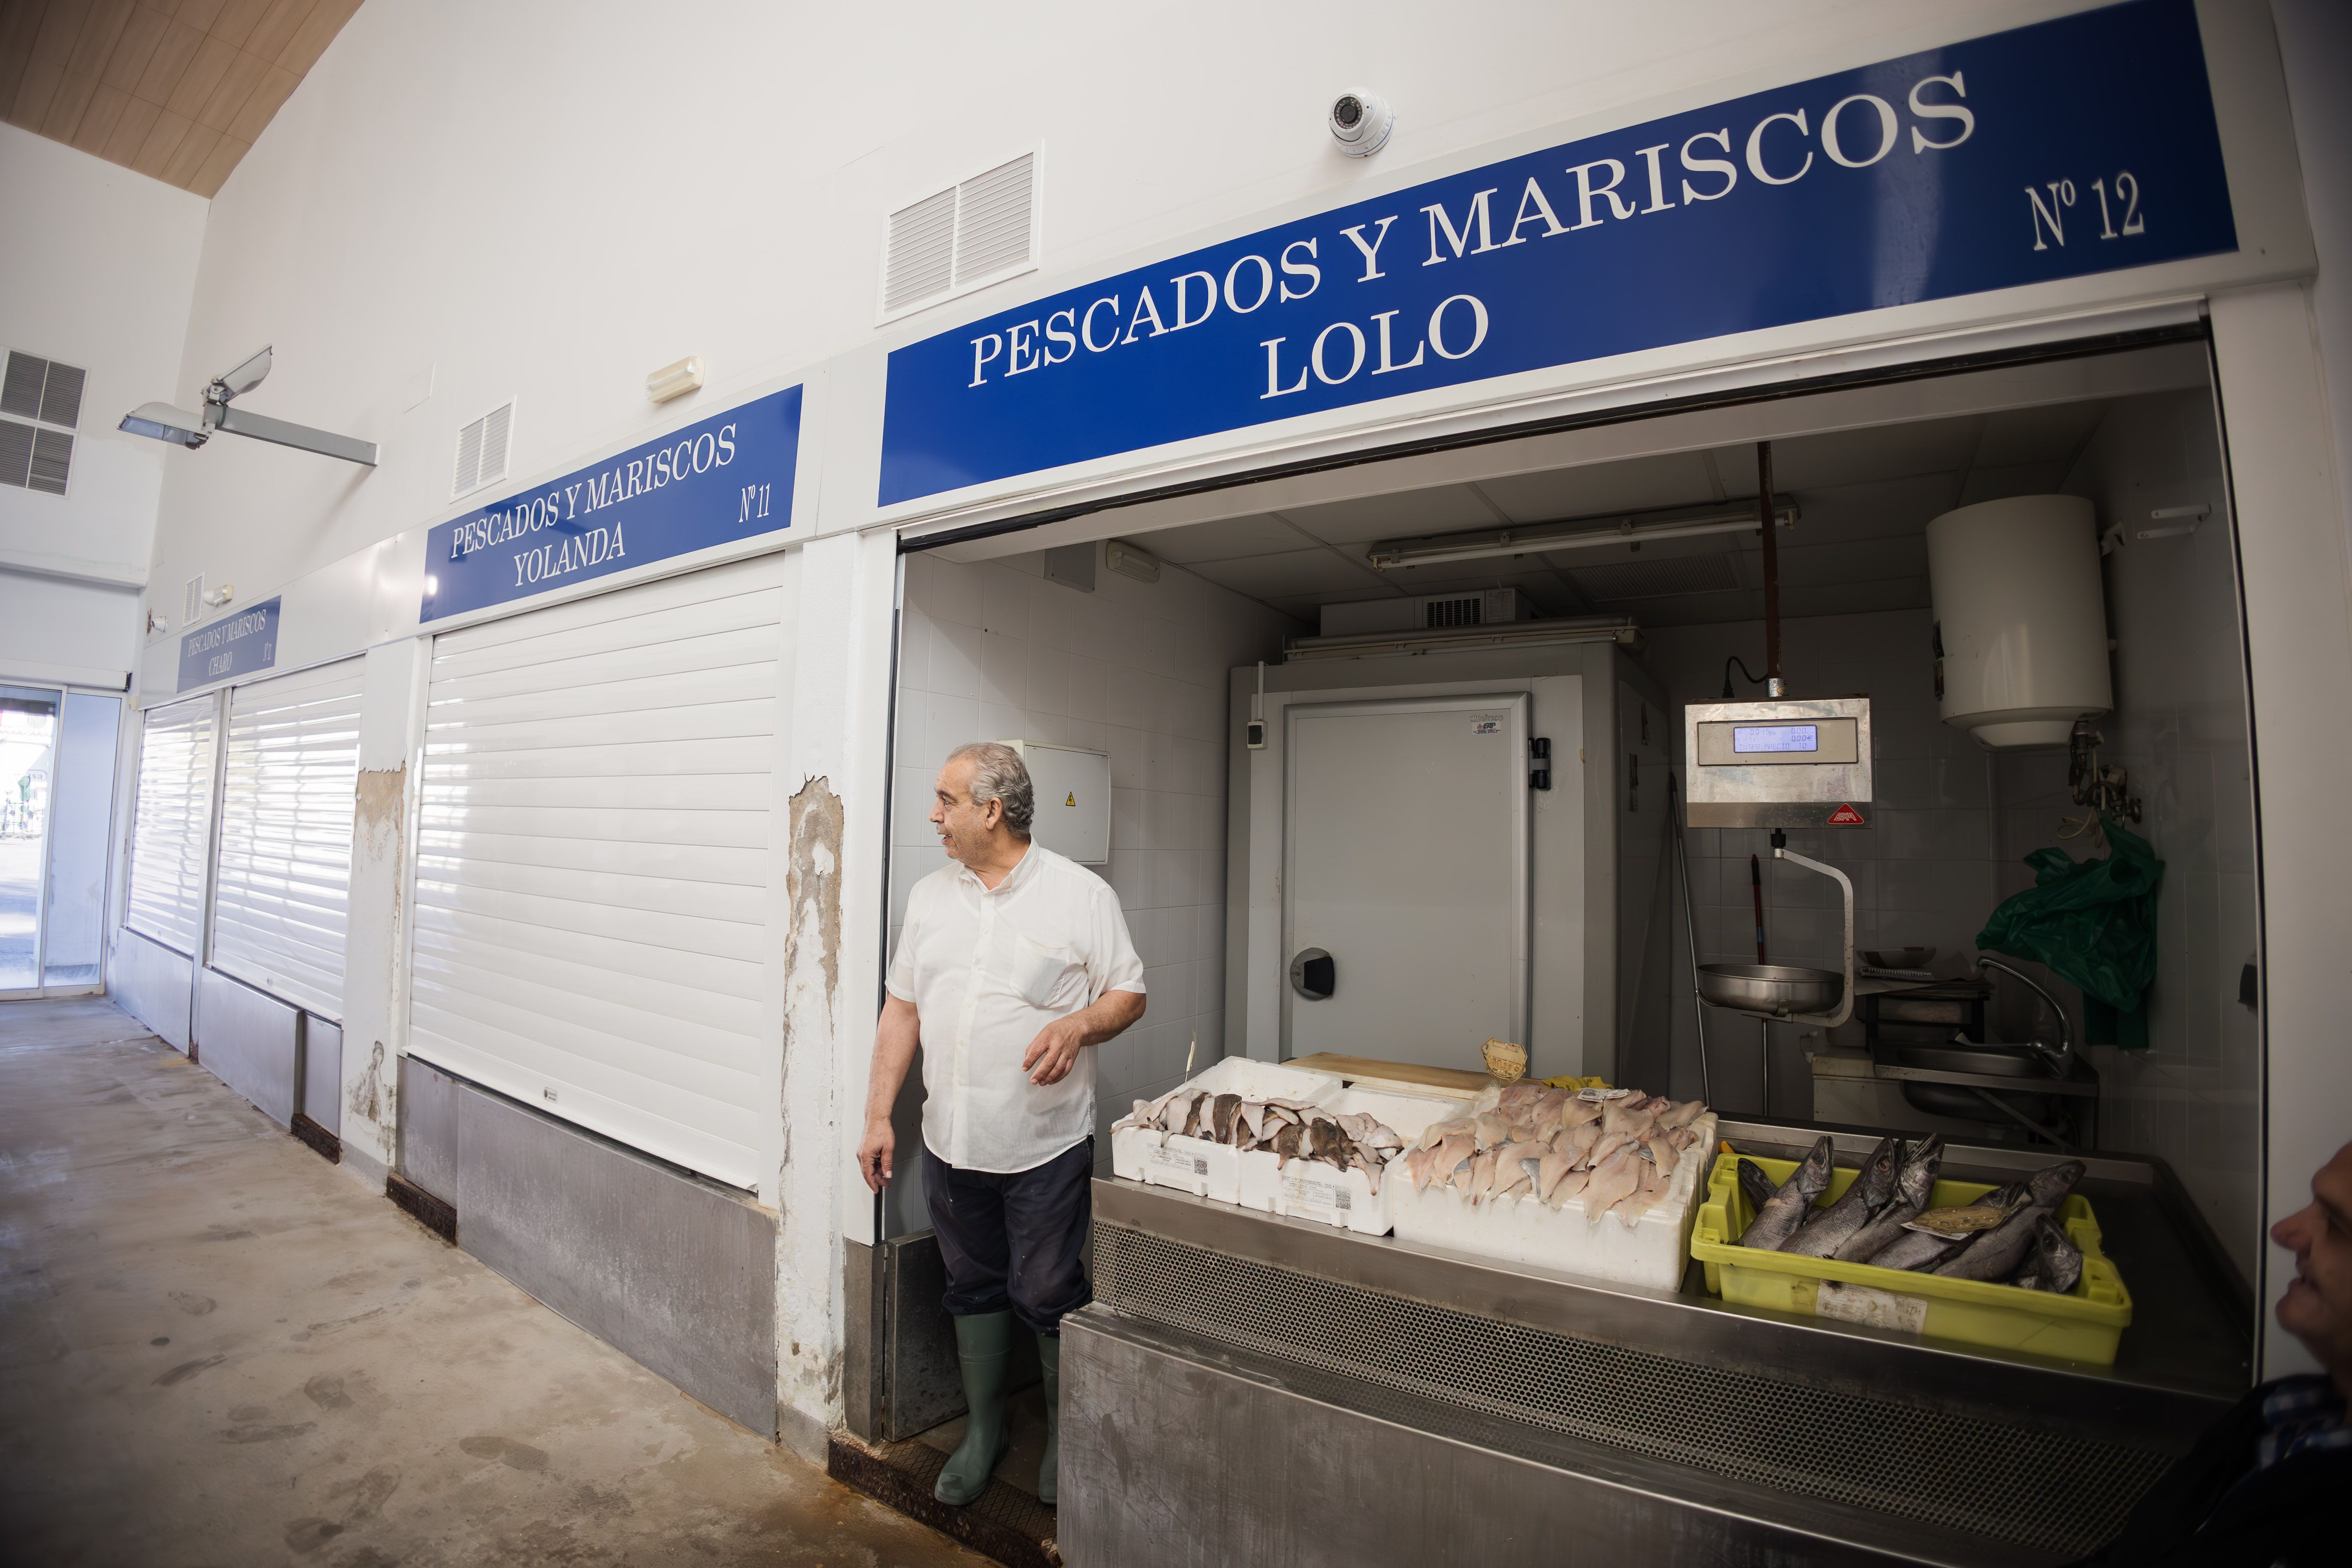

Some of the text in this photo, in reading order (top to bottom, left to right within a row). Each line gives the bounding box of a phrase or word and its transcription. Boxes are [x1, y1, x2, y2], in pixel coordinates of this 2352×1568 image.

[968, 70, 1975, 388] PESCADOS Y MARISCOS
[2092, 172, 2144, 240] 12
[1259, 294, 1489, 400] LOLO
[450, 423, 736, 559] PESCADOS Y MARISCOS
[757, 482, 771, 518] 11
[513, 521, 626, 587] YOLANDA
[187, 609, 266, 657] PESCADOS Y MARISCOS
[208, 651, 233, 677] CHARO
[1833, 812, 1857, 821] EXA
